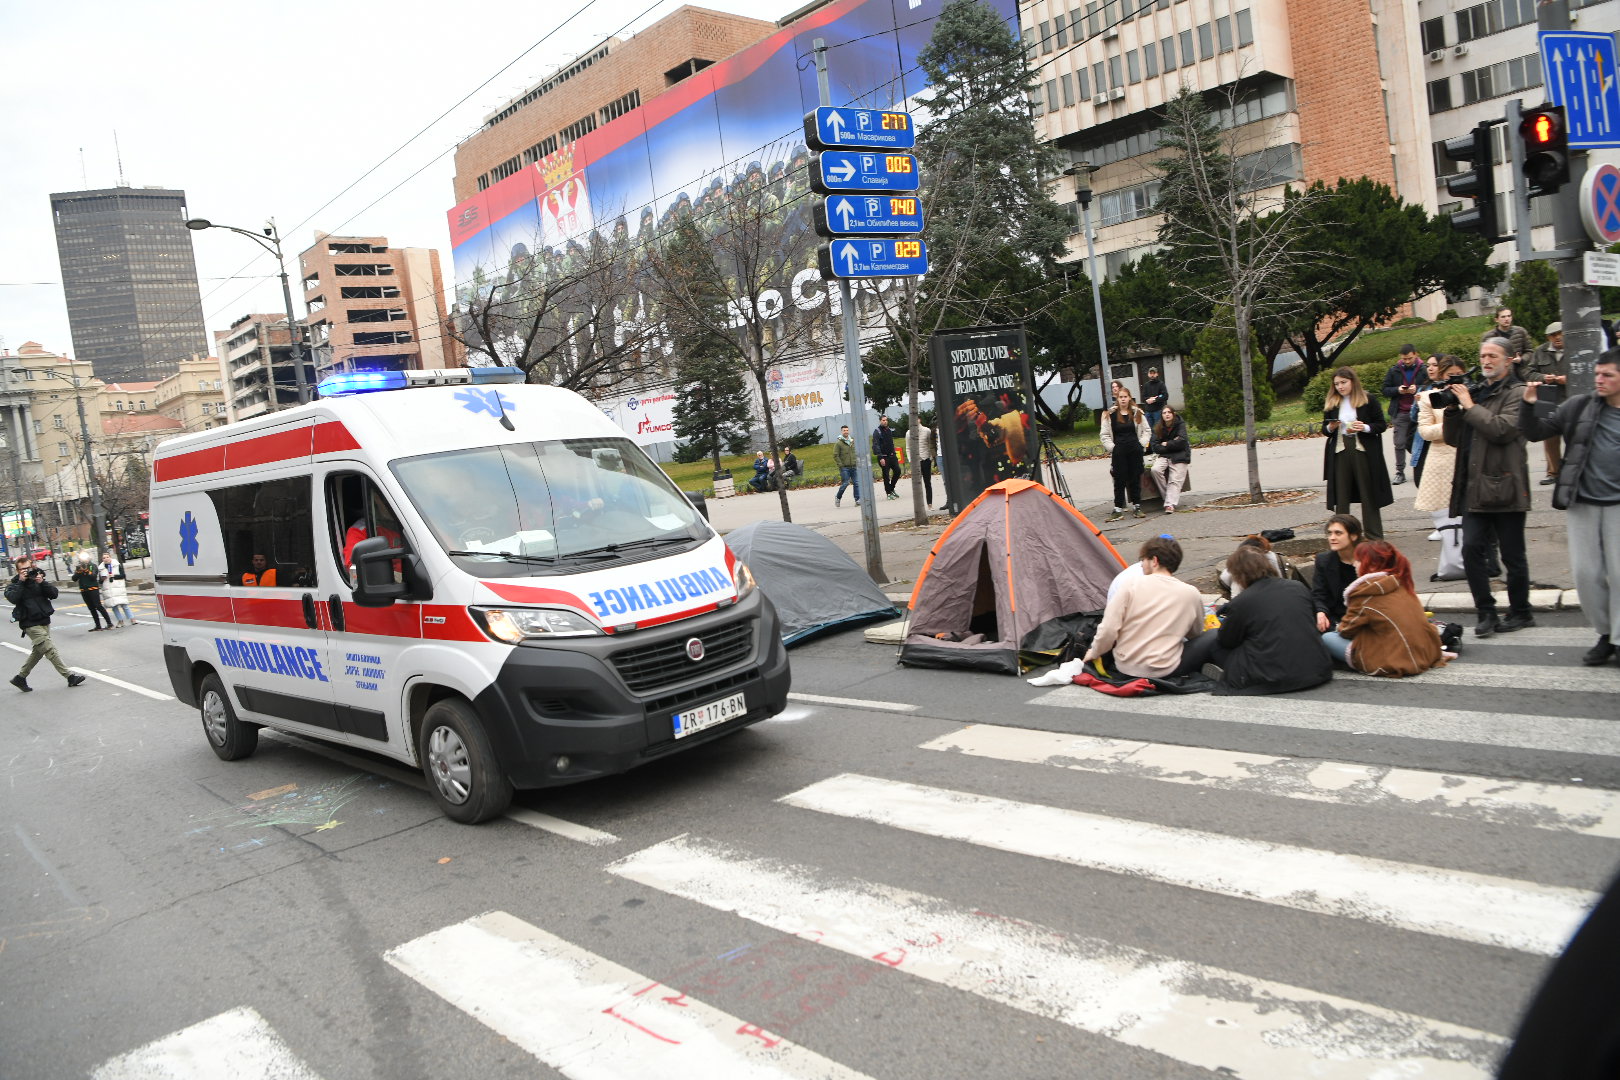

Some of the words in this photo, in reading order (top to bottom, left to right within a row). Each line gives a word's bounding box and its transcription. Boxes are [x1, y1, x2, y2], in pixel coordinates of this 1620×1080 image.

[881, 113, 907, 130] 277
[840, 131, 855, 140] 500m
[862, 157, 873, 172] P
[885, 156, 911, 173] 005
[861, 176, 888, 185] Славија
[890, 198, 915, 215] 040
[866, 219, 898, 227] Обилићев
[899, 220, 918, 228] венац
[872, 243, 882, 259] P
[894, 241, 920, 258] 029
[871, 263, 909, 271] Калемегдан
[779, 390, 824, 409] TRAYAL
[645, 423, 673, 433] YUMCO
[214, 637, 329, 683] AMBULANCE
[682, 712, 698, 730] ZR
